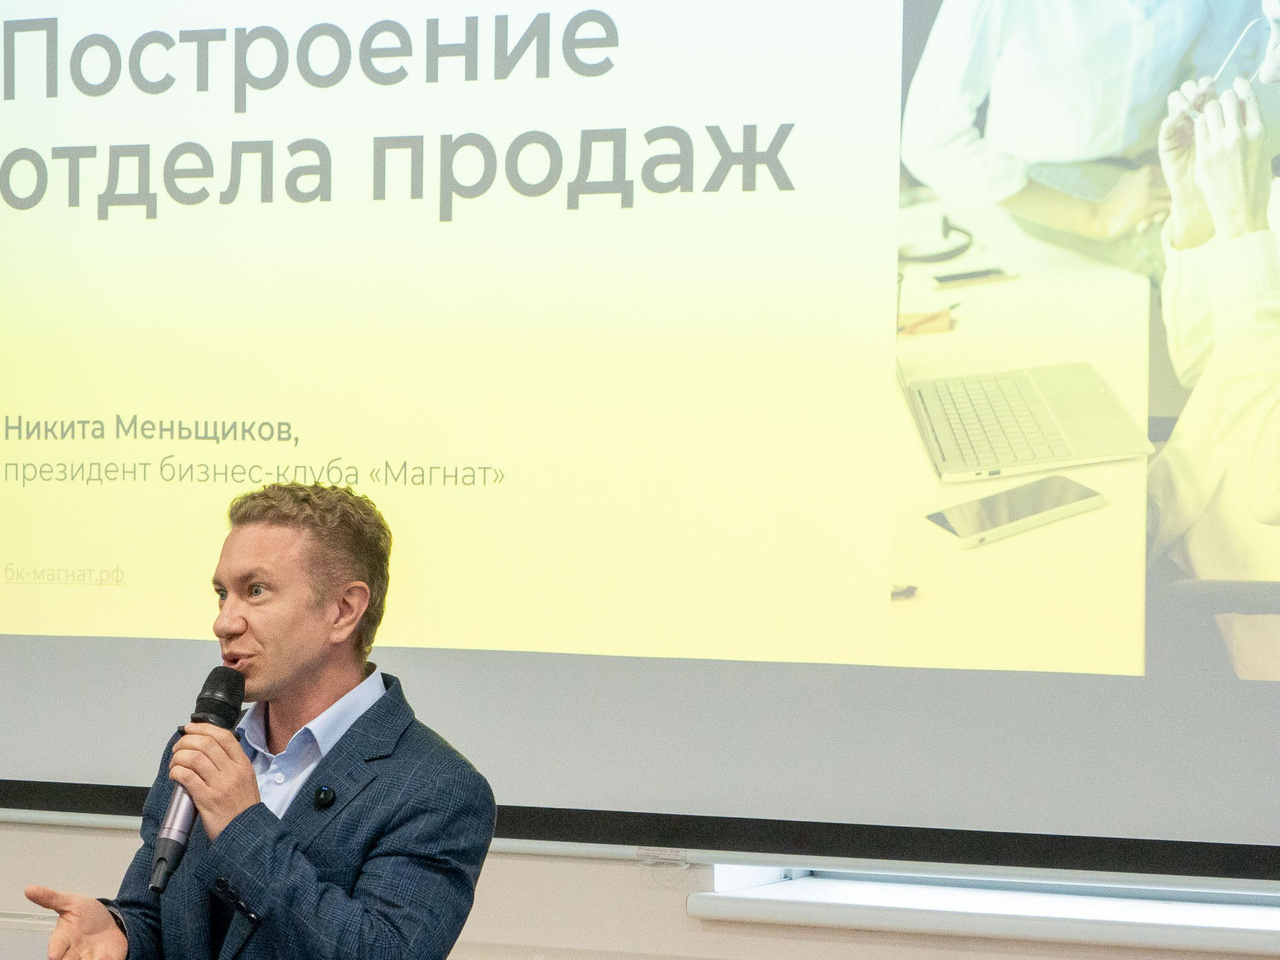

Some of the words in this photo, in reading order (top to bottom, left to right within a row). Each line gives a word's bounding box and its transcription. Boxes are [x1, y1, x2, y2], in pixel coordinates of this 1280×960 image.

[2, 8, 620, 114] Построение
[372, 122, 795, 222] продаж
[4, 415, 106, 441] Никита
[115, 414, 300, 448] Меньщиков,
[4, 458, 152, 487] президент
[160, 455, 359, 486] бизнес-клуба
[369, 460, 506, 486] «Магнат»
[4, 562, 126, 587] бк-магнат.рф
